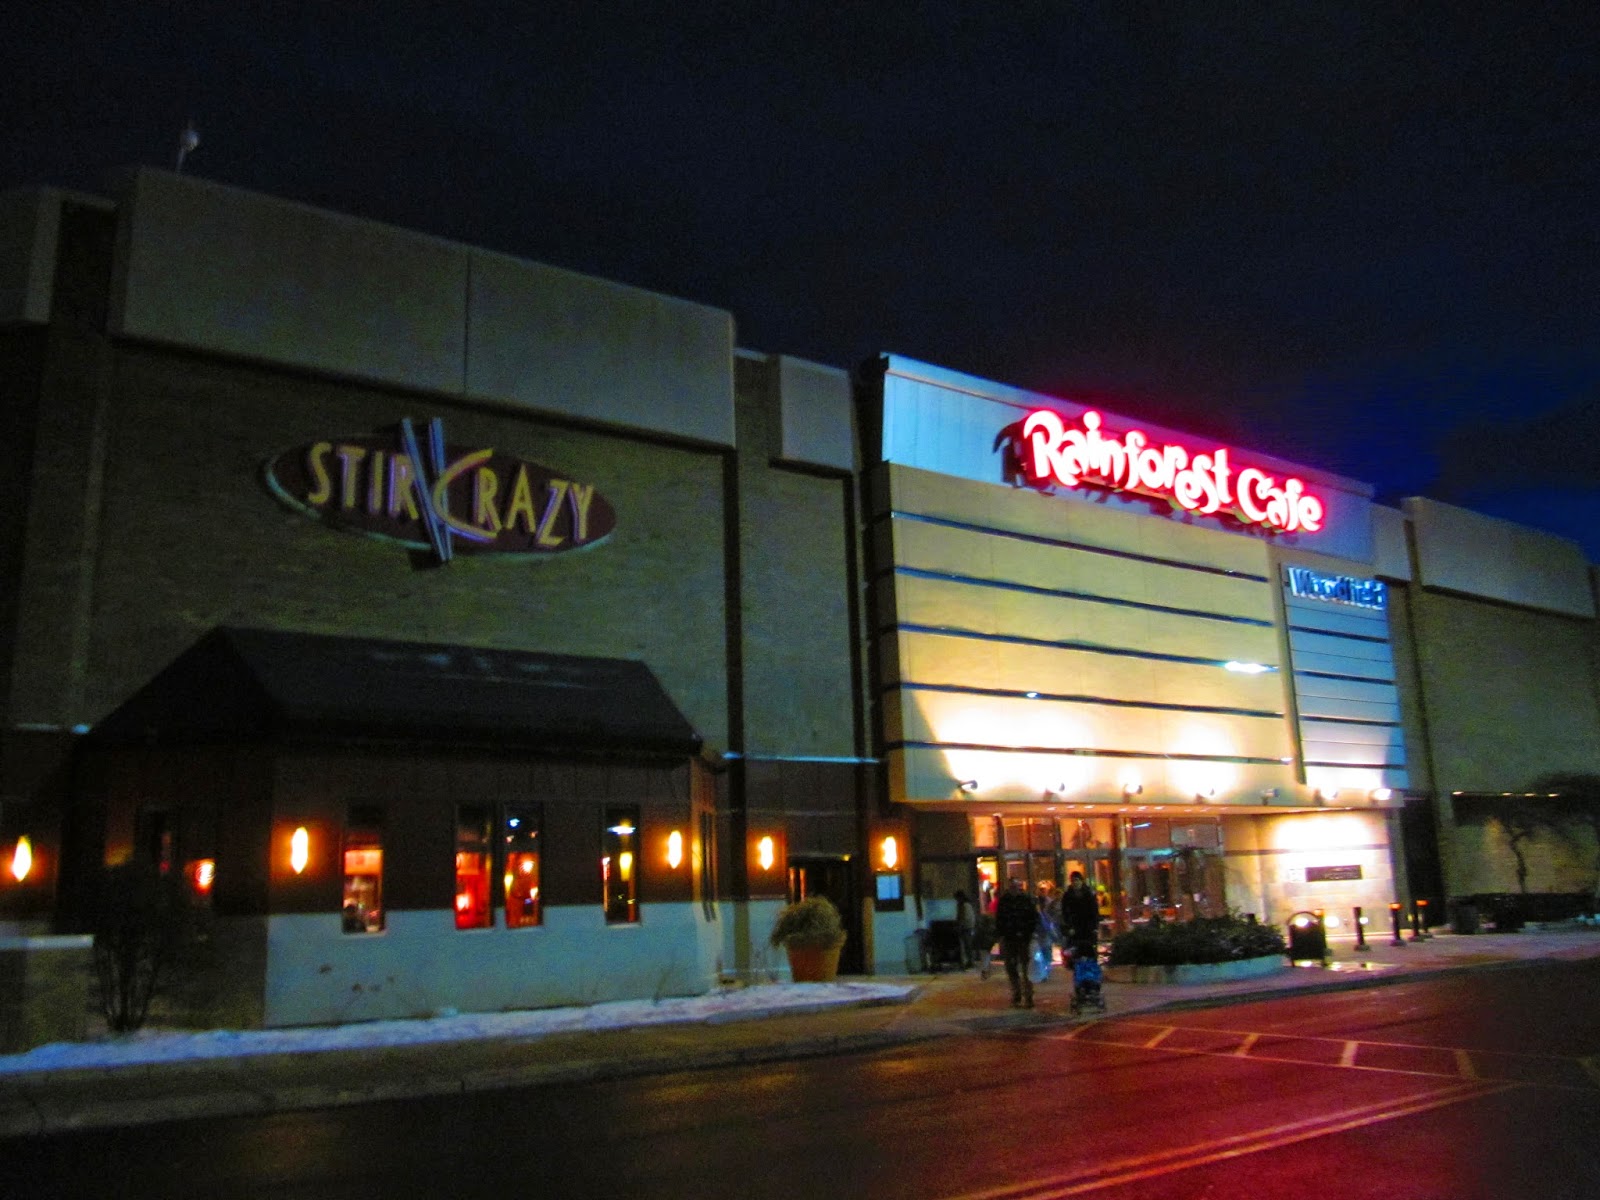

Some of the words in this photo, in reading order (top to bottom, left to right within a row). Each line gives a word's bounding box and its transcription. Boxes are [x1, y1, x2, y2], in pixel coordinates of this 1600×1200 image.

[307, 442, 420, 520] STIR
[432, 447, 594, 547] CRAZY
[1023, 409, 1232, 514] Rainforest
[1236, 468, 1323, 531] Cafe
